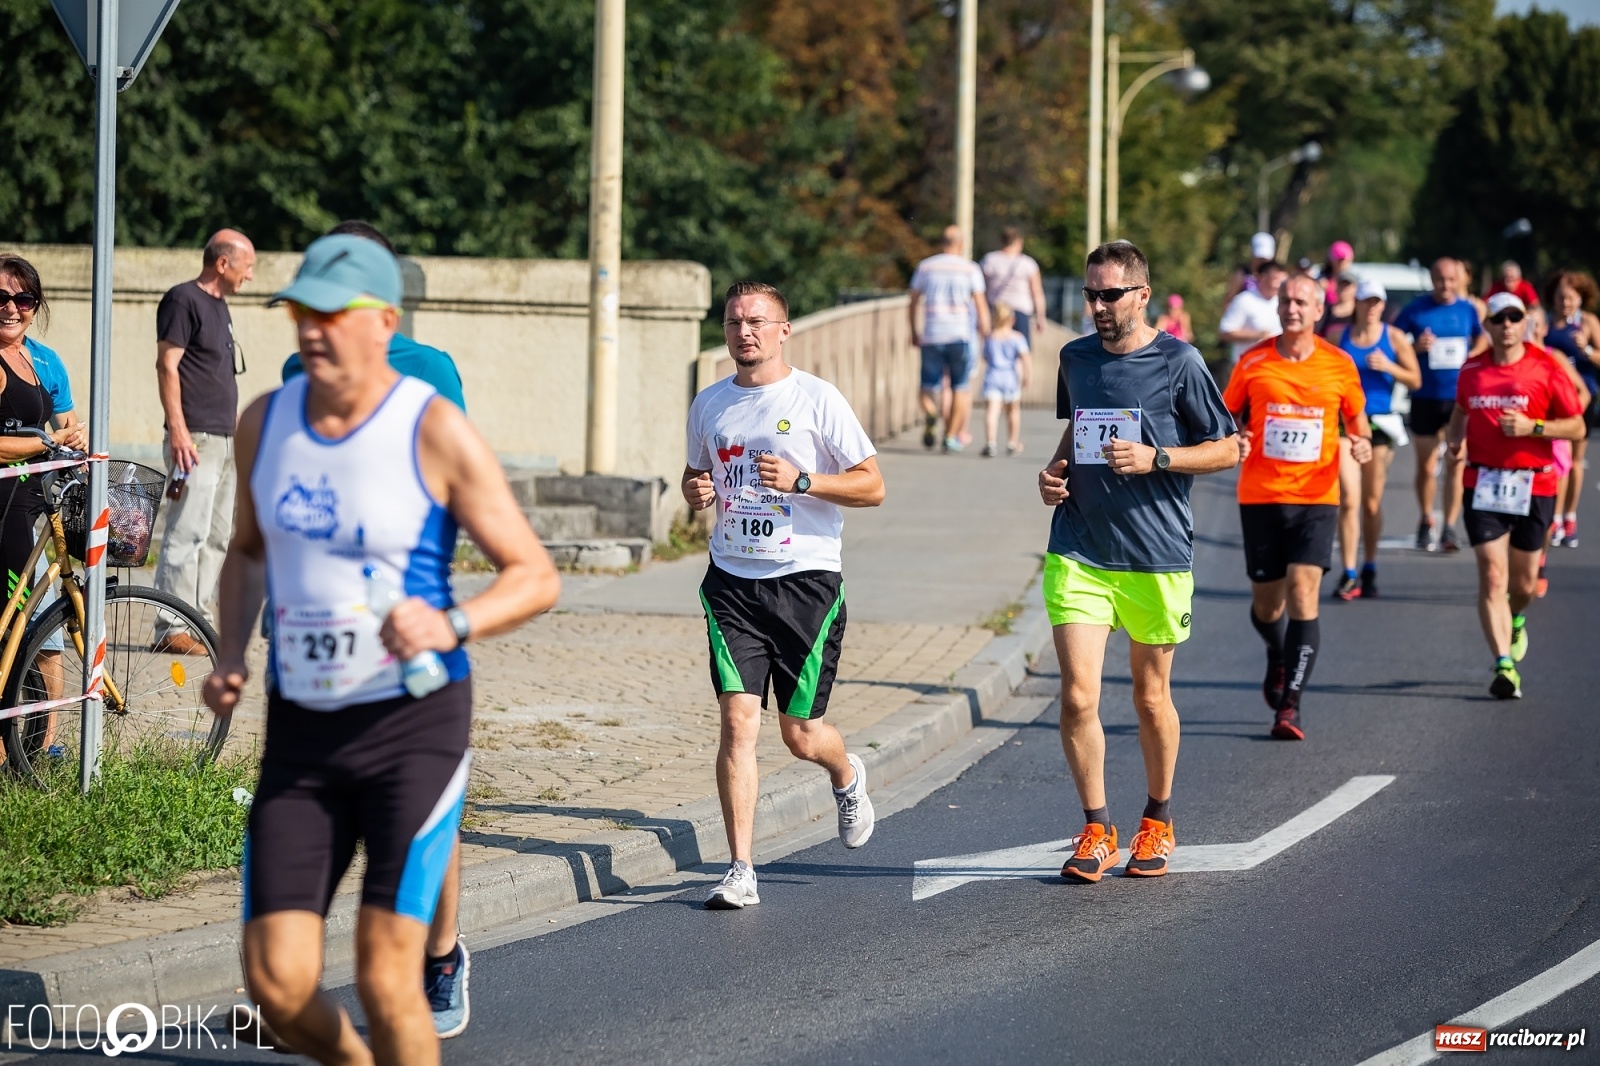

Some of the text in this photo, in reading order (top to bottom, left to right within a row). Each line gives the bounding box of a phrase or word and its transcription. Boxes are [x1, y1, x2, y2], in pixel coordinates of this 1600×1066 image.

[1098, 424, 1119, 441] 78
[1281, 431, 1307, 444] 277
[723, 463, 744, 489] XII
[760, 493, 784, 504] 2019
[741, 517, 774, 537] 180
[304, 631, 357, 661] 297
